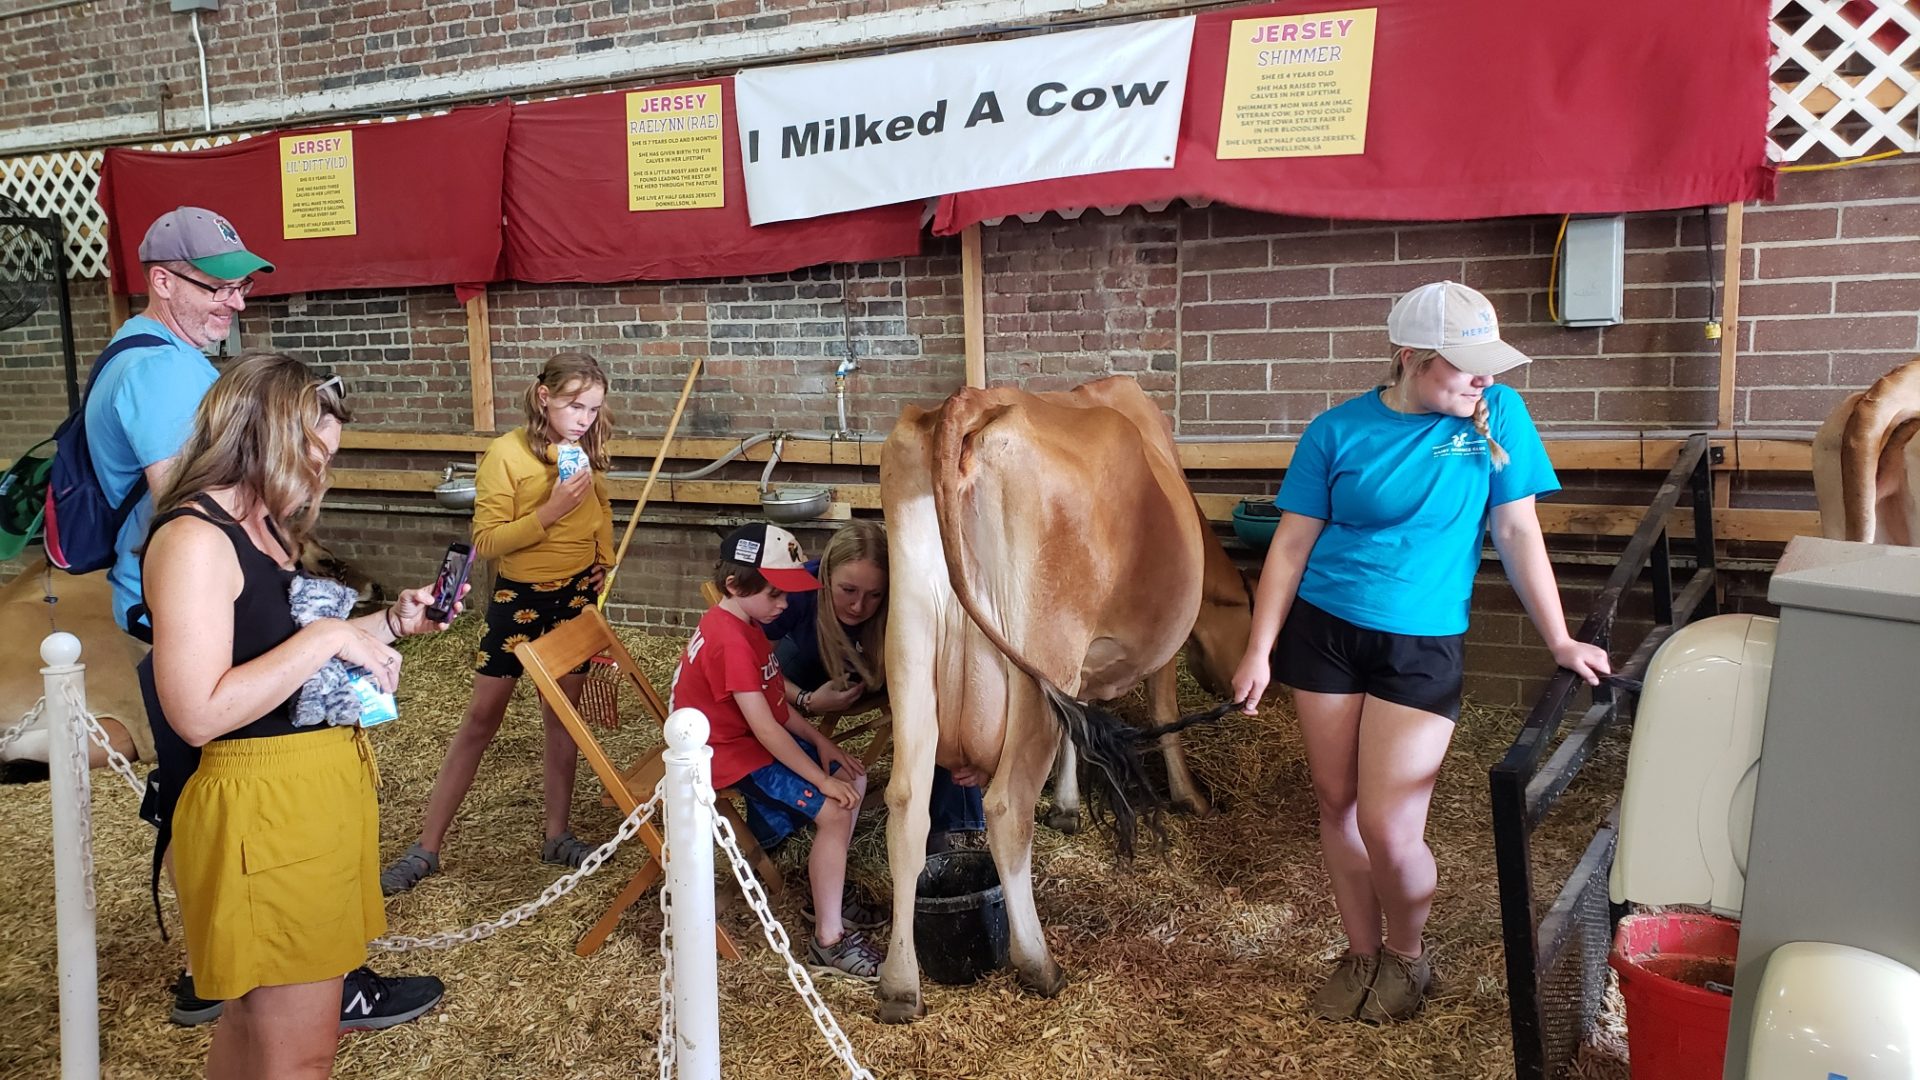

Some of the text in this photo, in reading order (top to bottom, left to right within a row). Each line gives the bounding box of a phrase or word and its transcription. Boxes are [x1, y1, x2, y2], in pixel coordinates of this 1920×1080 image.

[1251, 19, 1353, 43] JERSEY
[1258, 46, 1342, 66] SHIMMER
[641, 94, 706, 113] JERSEY
[630, 114, 719, 134] RAELYNN (RAE)
[748, 80, 1170, 163] I Milked A Cow
[292, 138, 341, 154] JERSEY
